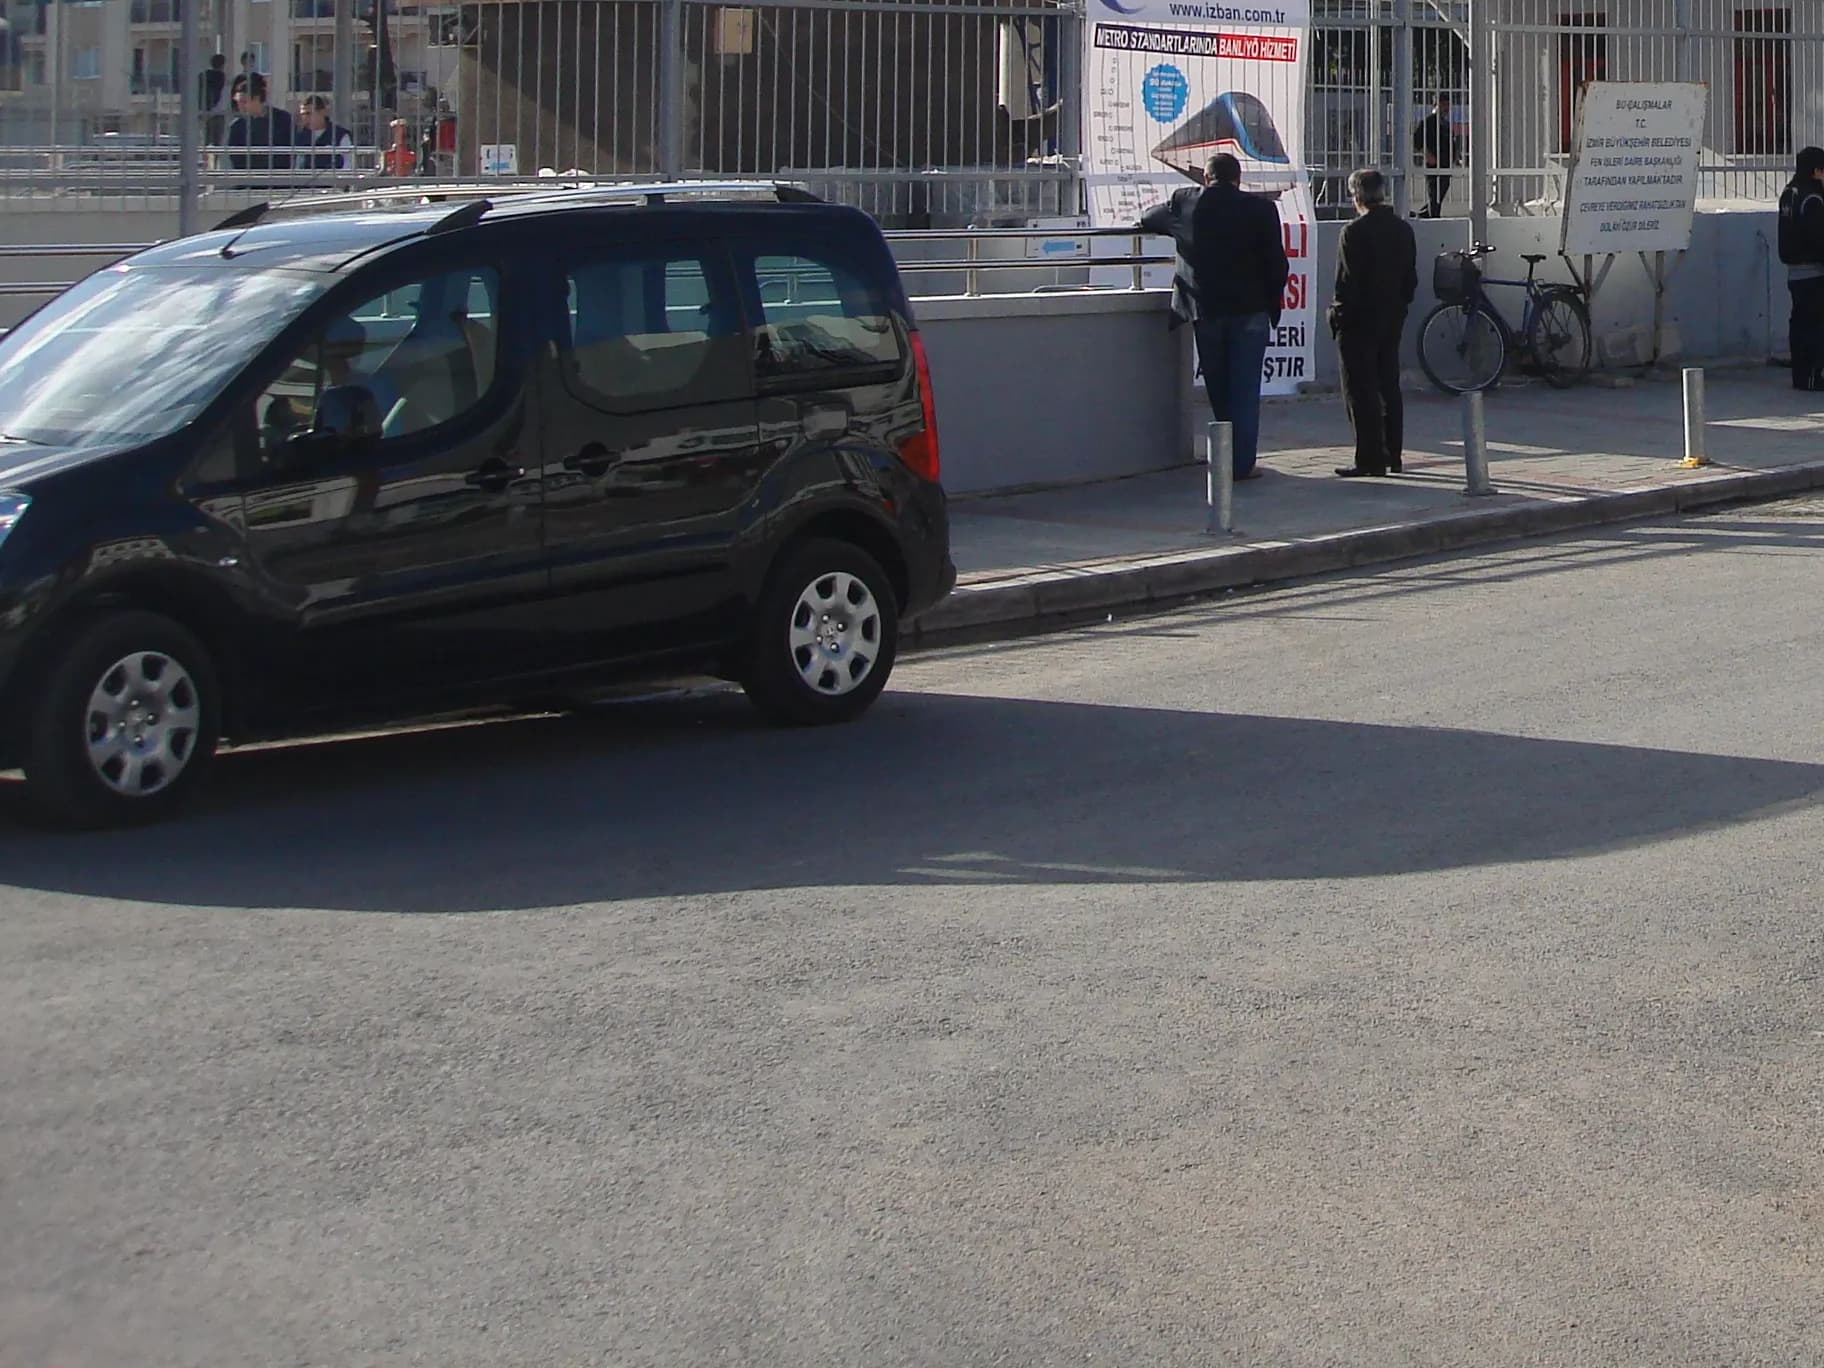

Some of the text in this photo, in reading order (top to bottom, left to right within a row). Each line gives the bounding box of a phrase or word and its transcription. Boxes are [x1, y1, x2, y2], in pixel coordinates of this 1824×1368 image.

[1169, 2, 1285, 23] www.izban.com.tr
[1096, 28, 1129, 48] METRO
[1130, 31, 1217, 55] STANDARTLARINDA
